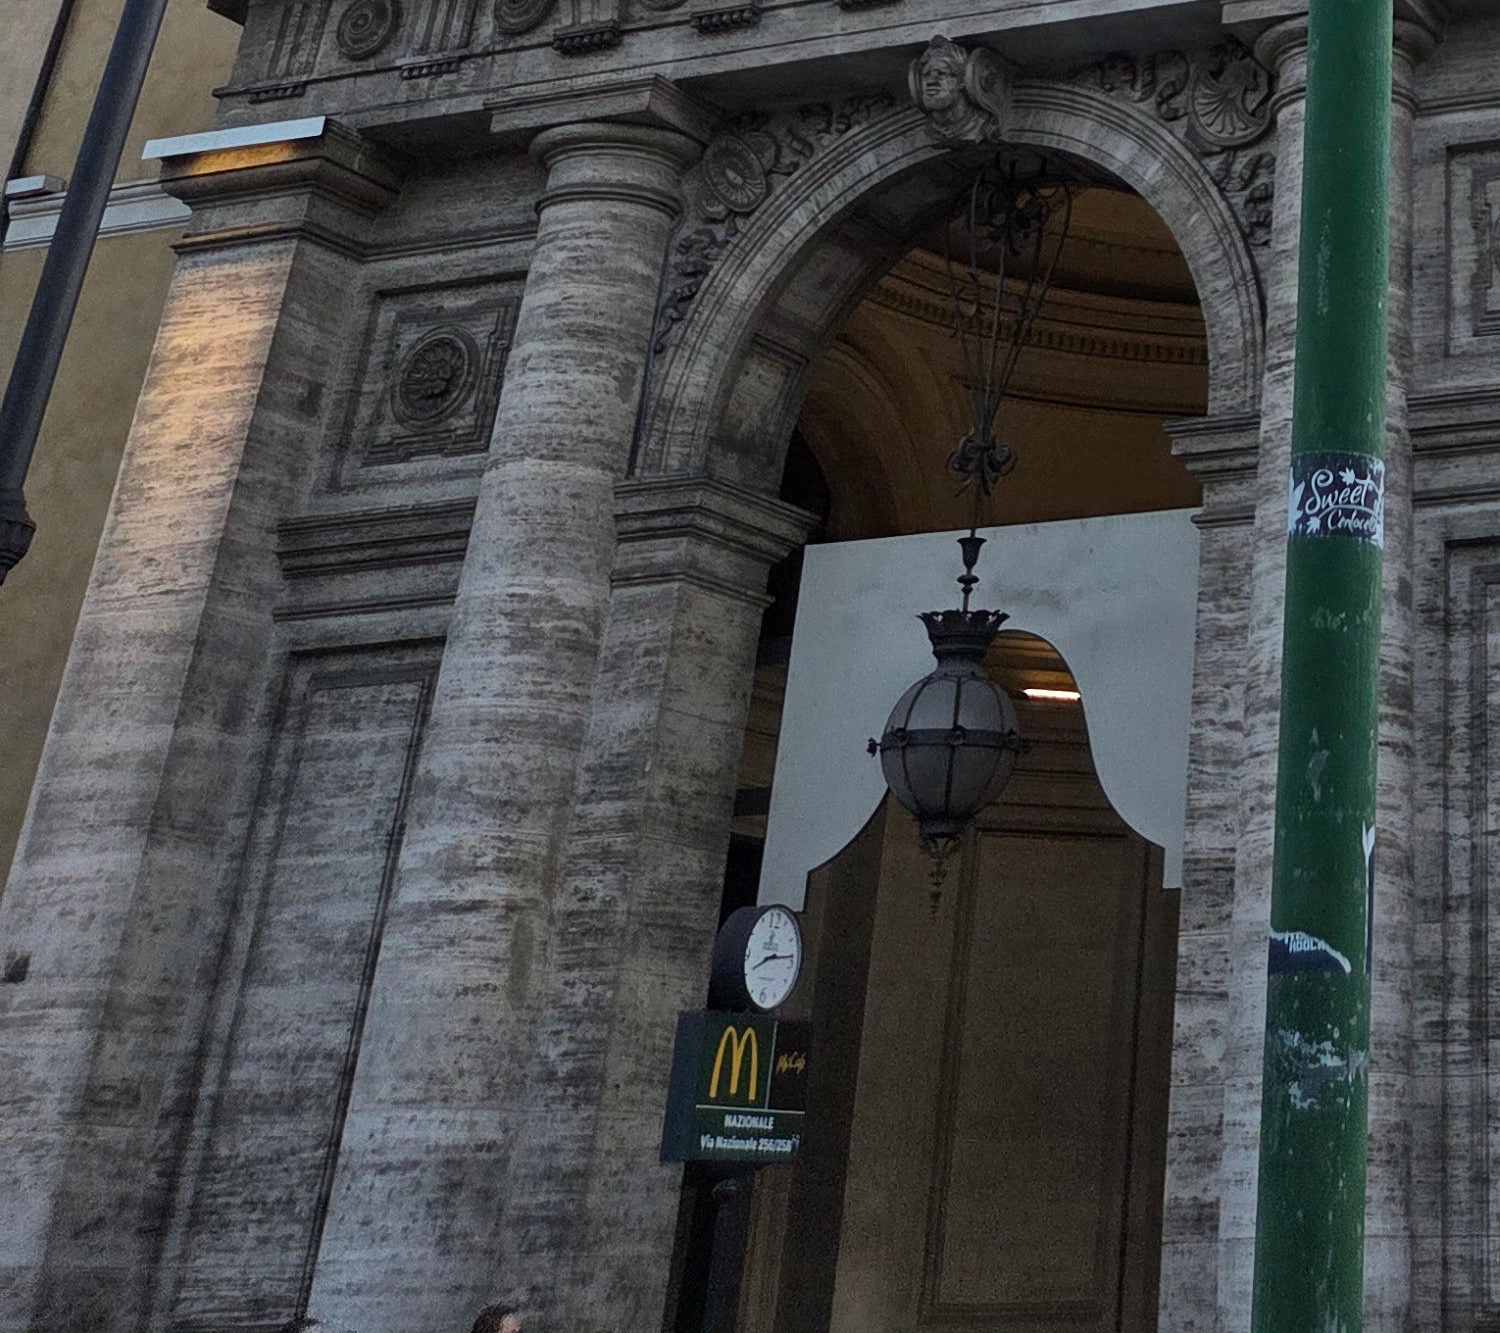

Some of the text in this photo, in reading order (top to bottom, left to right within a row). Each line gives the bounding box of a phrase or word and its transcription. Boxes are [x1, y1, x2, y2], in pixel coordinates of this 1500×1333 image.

[1305, 469, 1368, 515] Sweet
[708, 1025, 758, 1101] M
[724, 1114, 775, 1130] NAZIONALE
[700, 1134, 715, 1152] Via
[715, 1135, 757, 1151] Nazionale
